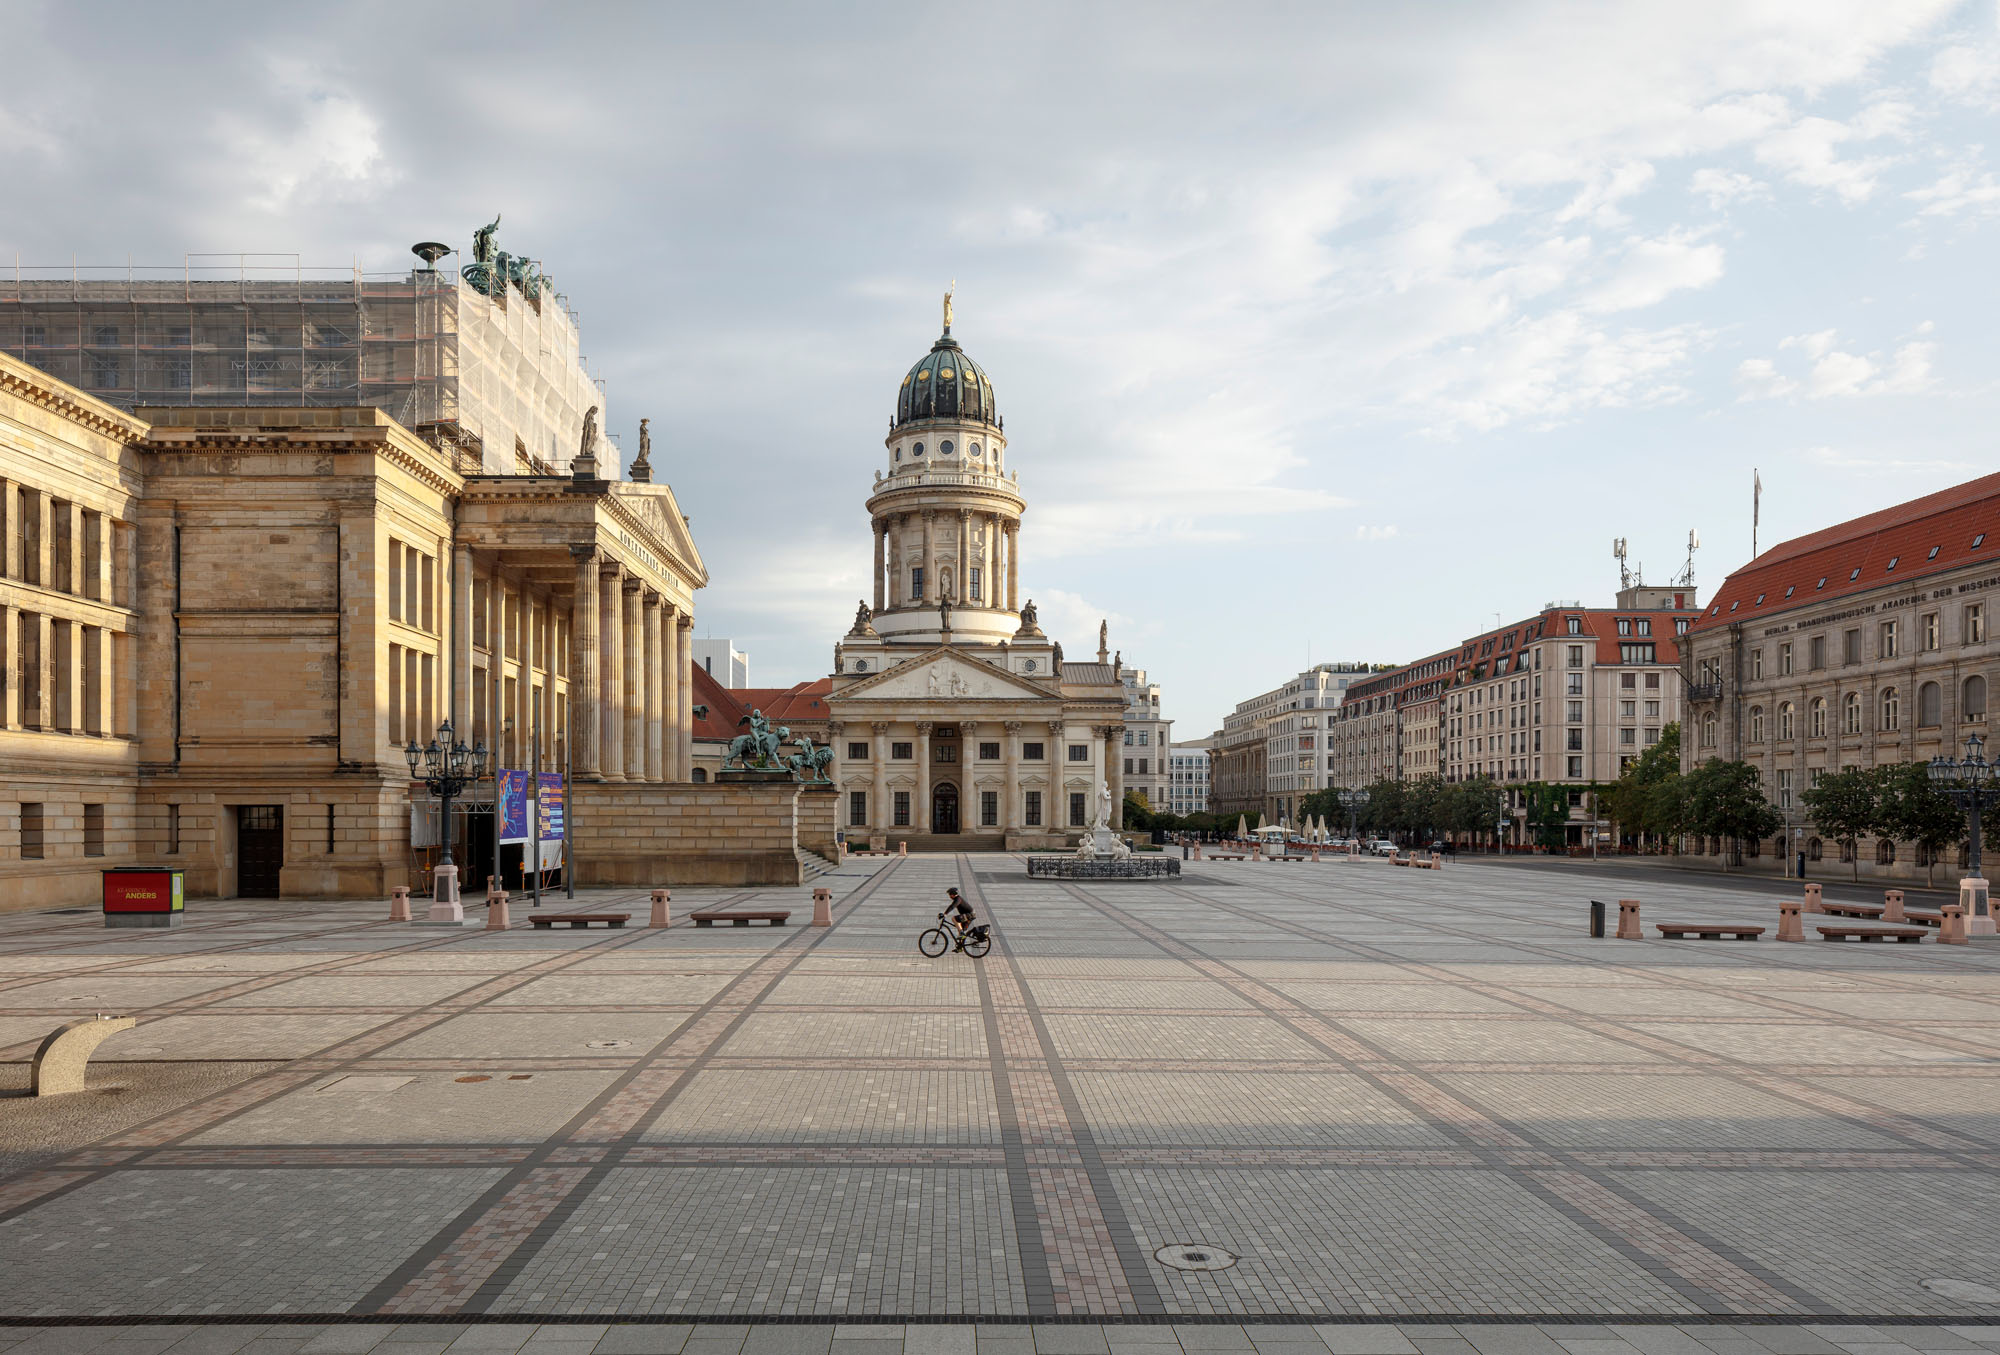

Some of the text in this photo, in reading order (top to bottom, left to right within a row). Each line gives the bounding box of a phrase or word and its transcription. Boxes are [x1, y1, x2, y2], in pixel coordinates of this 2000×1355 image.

[661, 567, 679, 588] BERLIN
[1764, 625, 1789, 636] BERLIN
[1881, 593, 1927, 611] AKADEMIE
[1933, 587, 1953, 599] DER
